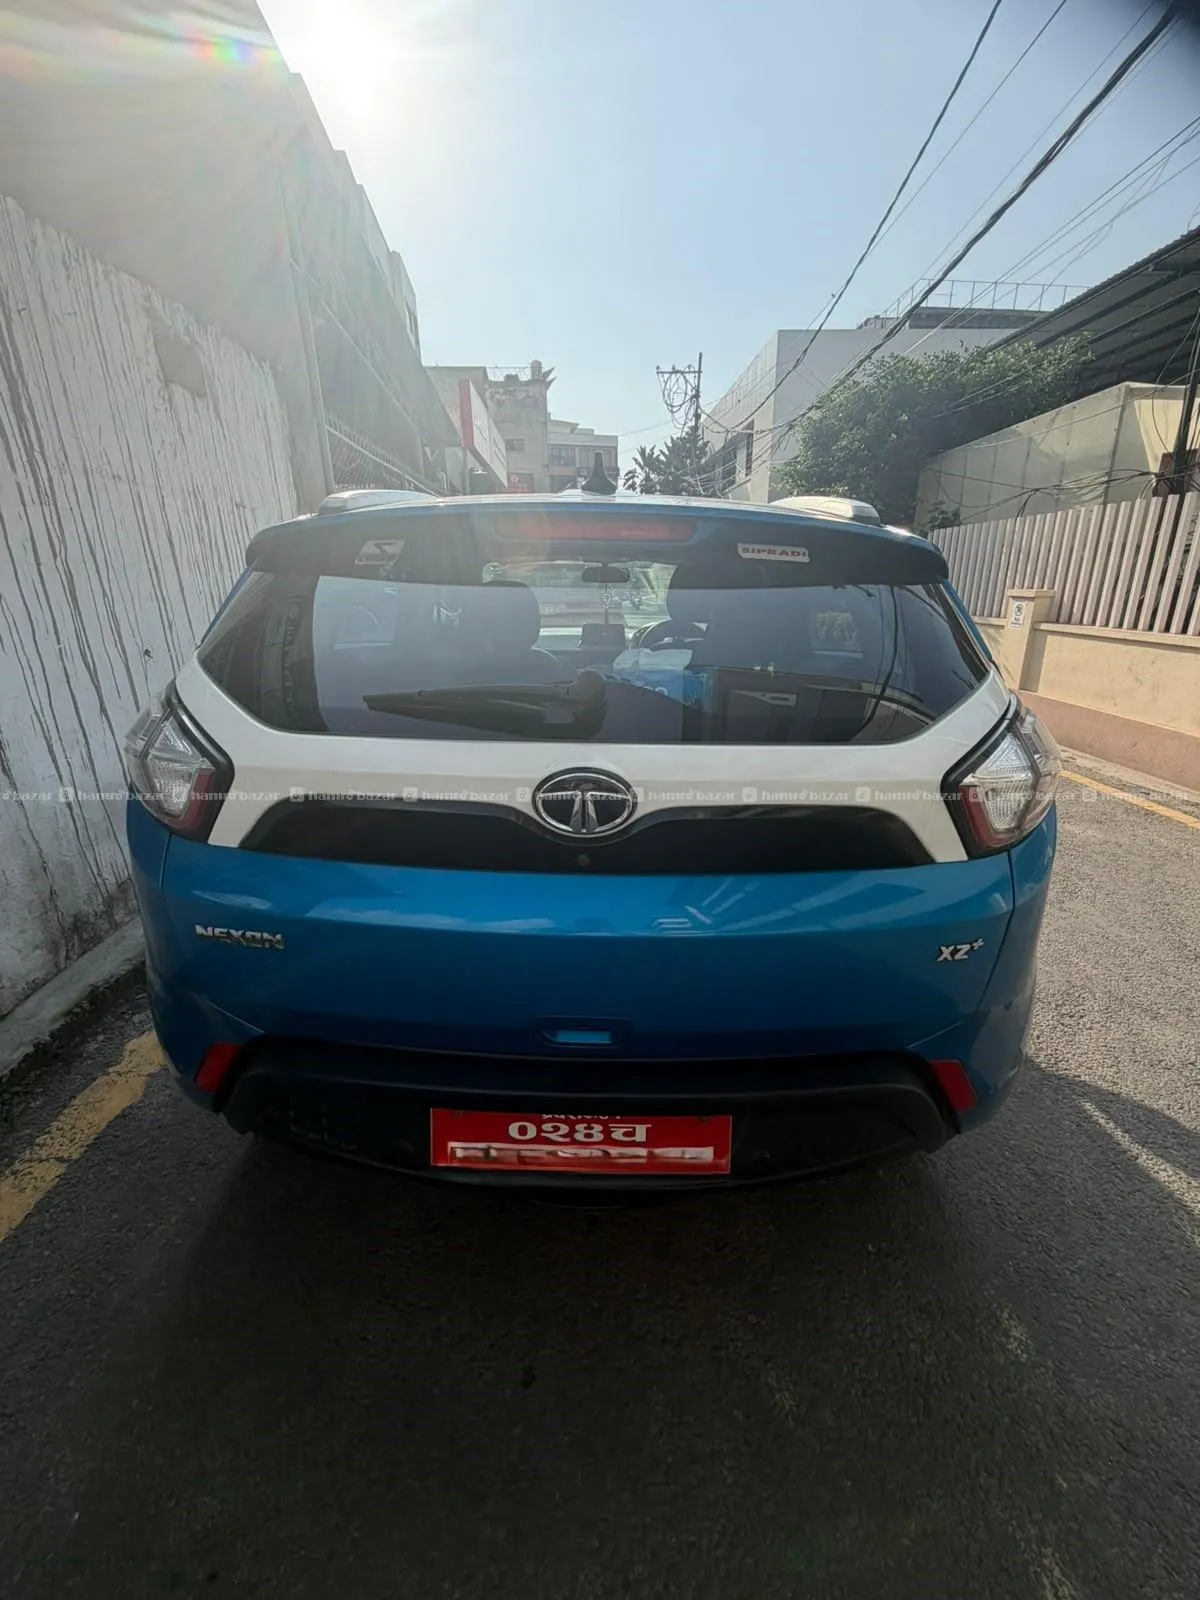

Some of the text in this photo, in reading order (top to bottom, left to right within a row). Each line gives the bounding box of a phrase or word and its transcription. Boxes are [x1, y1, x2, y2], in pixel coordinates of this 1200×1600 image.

[741, 546, 807, 557] SIPRADI
[194, 924, 285, 950] NEXON
[936, 938, 985, 962] XZ+
